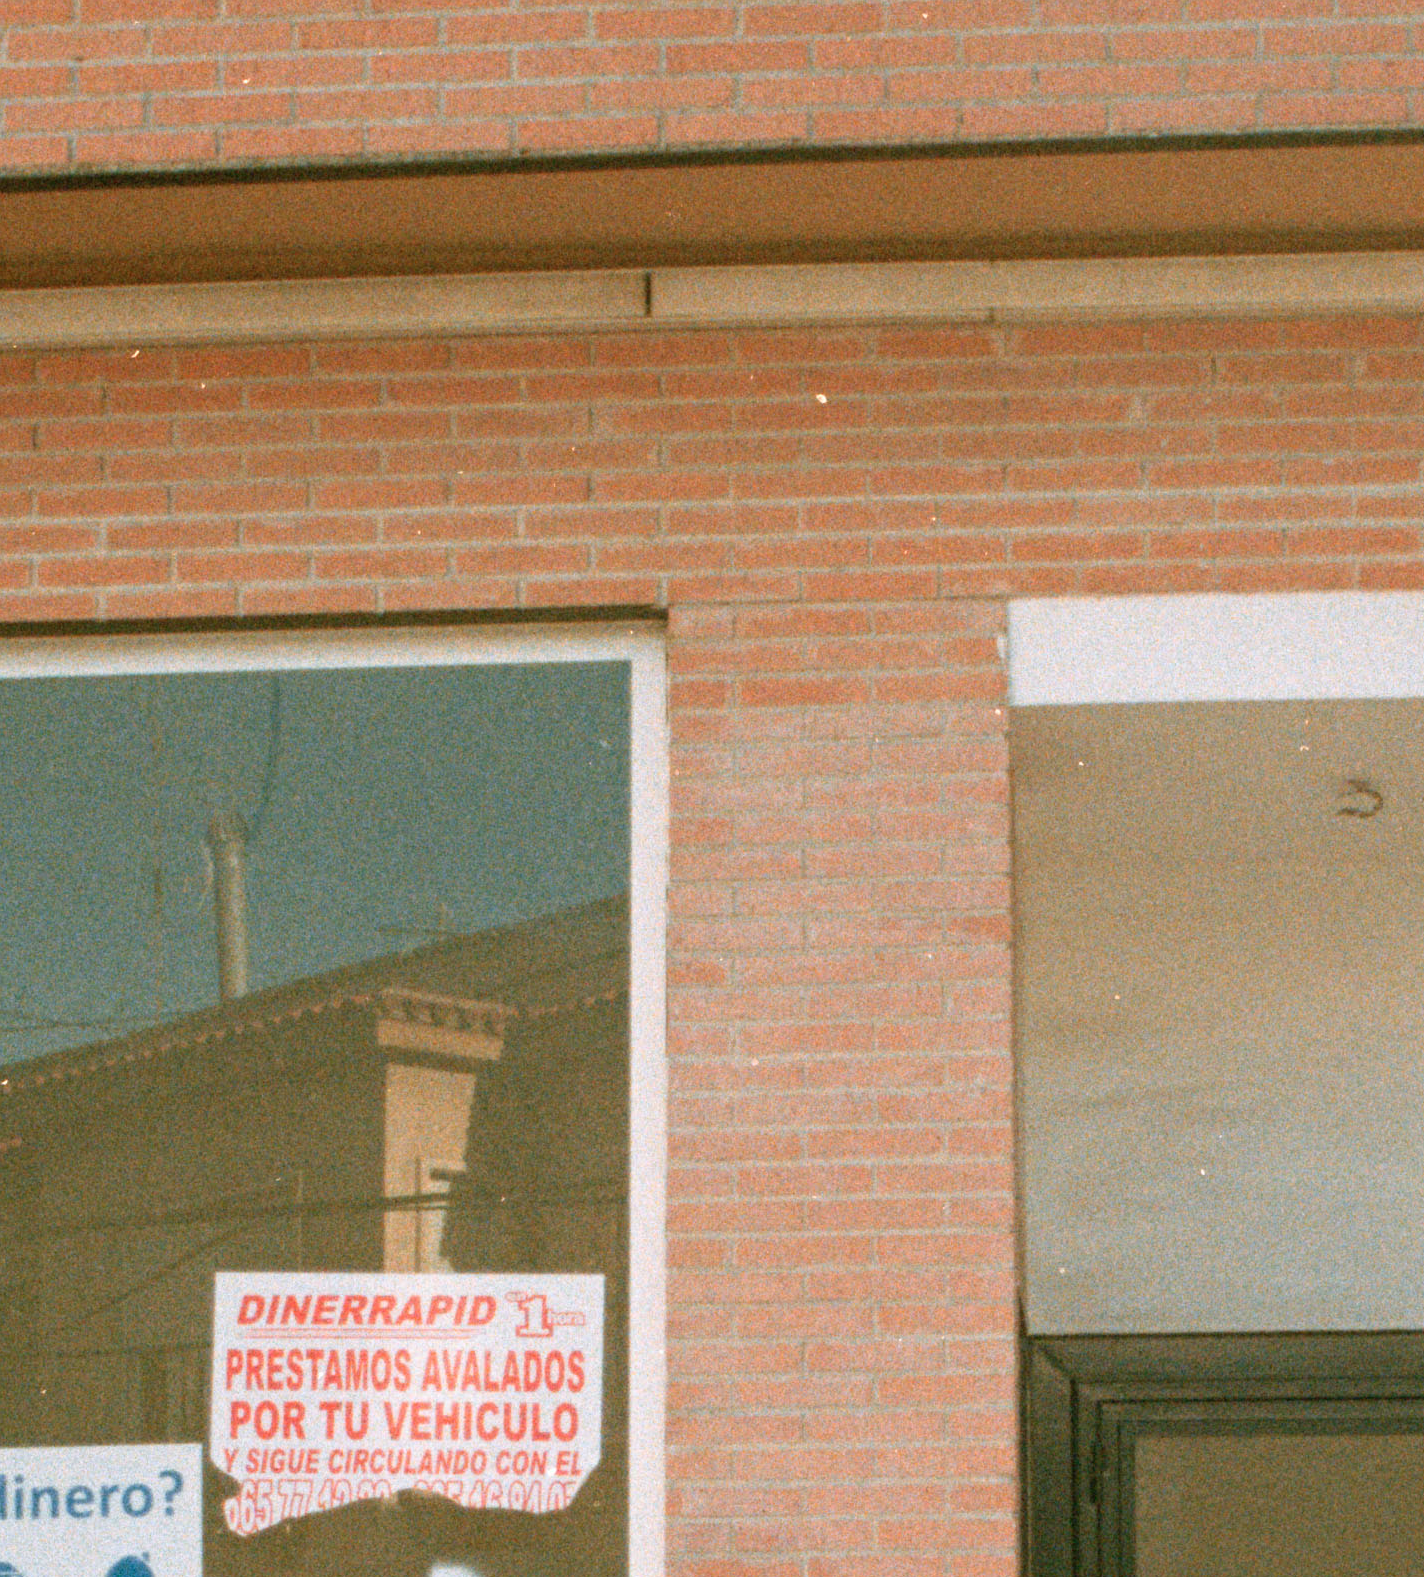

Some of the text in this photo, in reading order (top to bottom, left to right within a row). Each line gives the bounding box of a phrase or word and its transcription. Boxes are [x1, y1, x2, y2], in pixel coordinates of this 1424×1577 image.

[237, 1294, 497, 1325] DINERRAPID
[515, 1294, 553, 1337] 1
[225, 1348, 585, 1393] PRESTAMOS AVALADOS
[229, 1400, 579, 1442] POR TU VEHICULO
[223, 1448, 582, 1476] Y SIGUE CIRCULANDO CON EL
